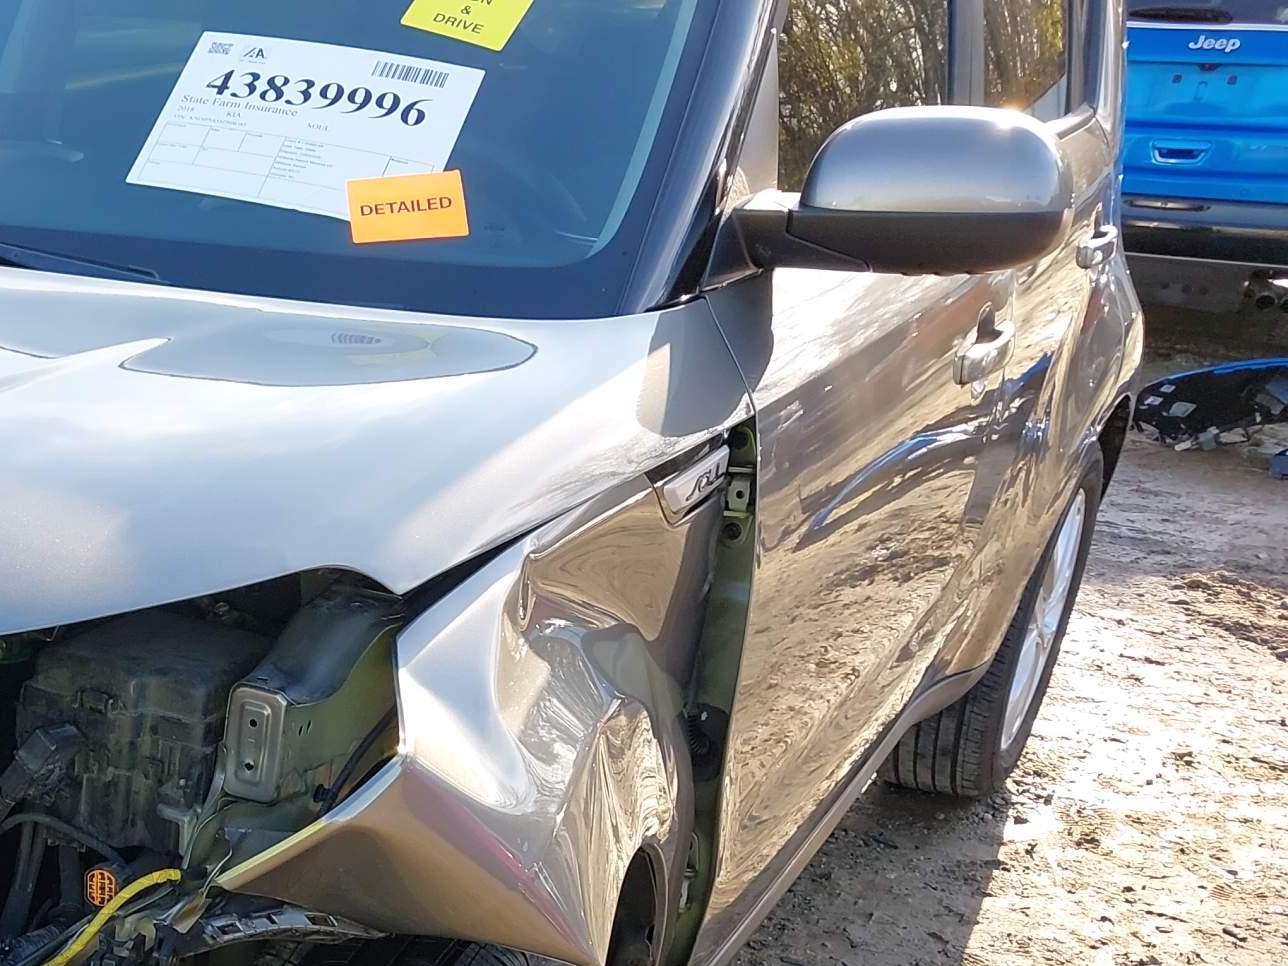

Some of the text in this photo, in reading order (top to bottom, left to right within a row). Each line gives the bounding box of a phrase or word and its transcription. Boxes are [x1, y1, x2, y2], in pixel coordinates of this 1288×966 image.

[460, 5, 472, 16] &
[433, 13, 484, 34] DRIVE
[1188, 35, 1241, 52] Jeep
[182, 95, 299, 117] State Farm Insurance
[206, 69, 433, 127] 43839996
[360, 196, 453, 216] DETAILED
